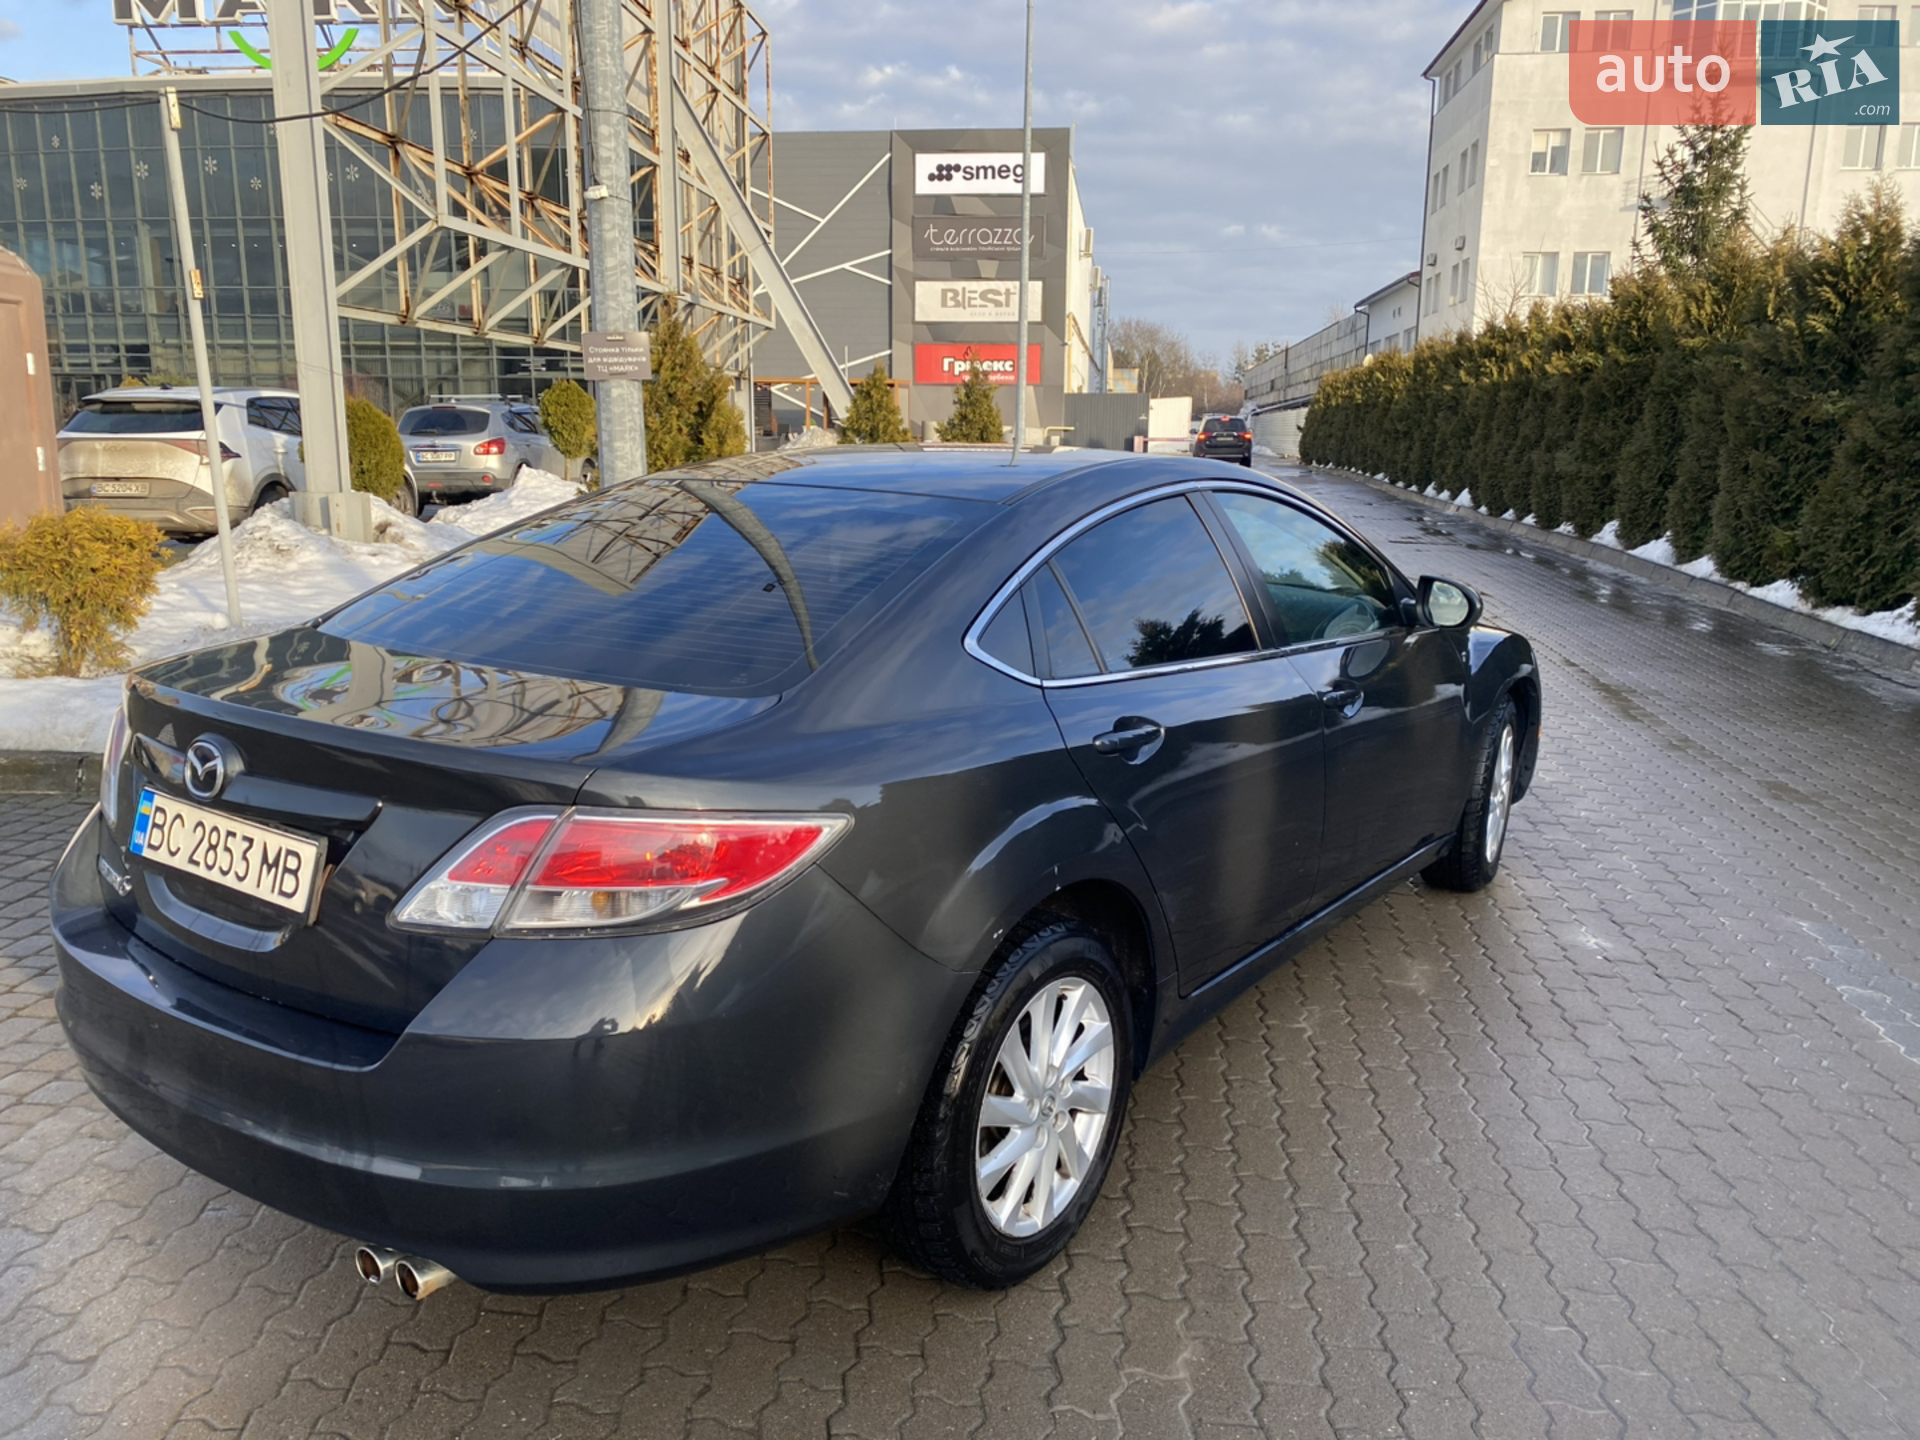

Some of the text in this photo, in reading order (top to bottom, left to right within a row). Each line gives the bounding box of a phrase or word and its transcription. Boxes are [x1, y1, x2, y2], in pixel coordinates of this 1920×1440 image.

[962, 164, 1024, 183] smeg
[133, 830, 145, 847] UA
[147, 806, 186, 858] BC
[188, 820, 254, 882] 2853
[256, 841, 302, 899] MB
